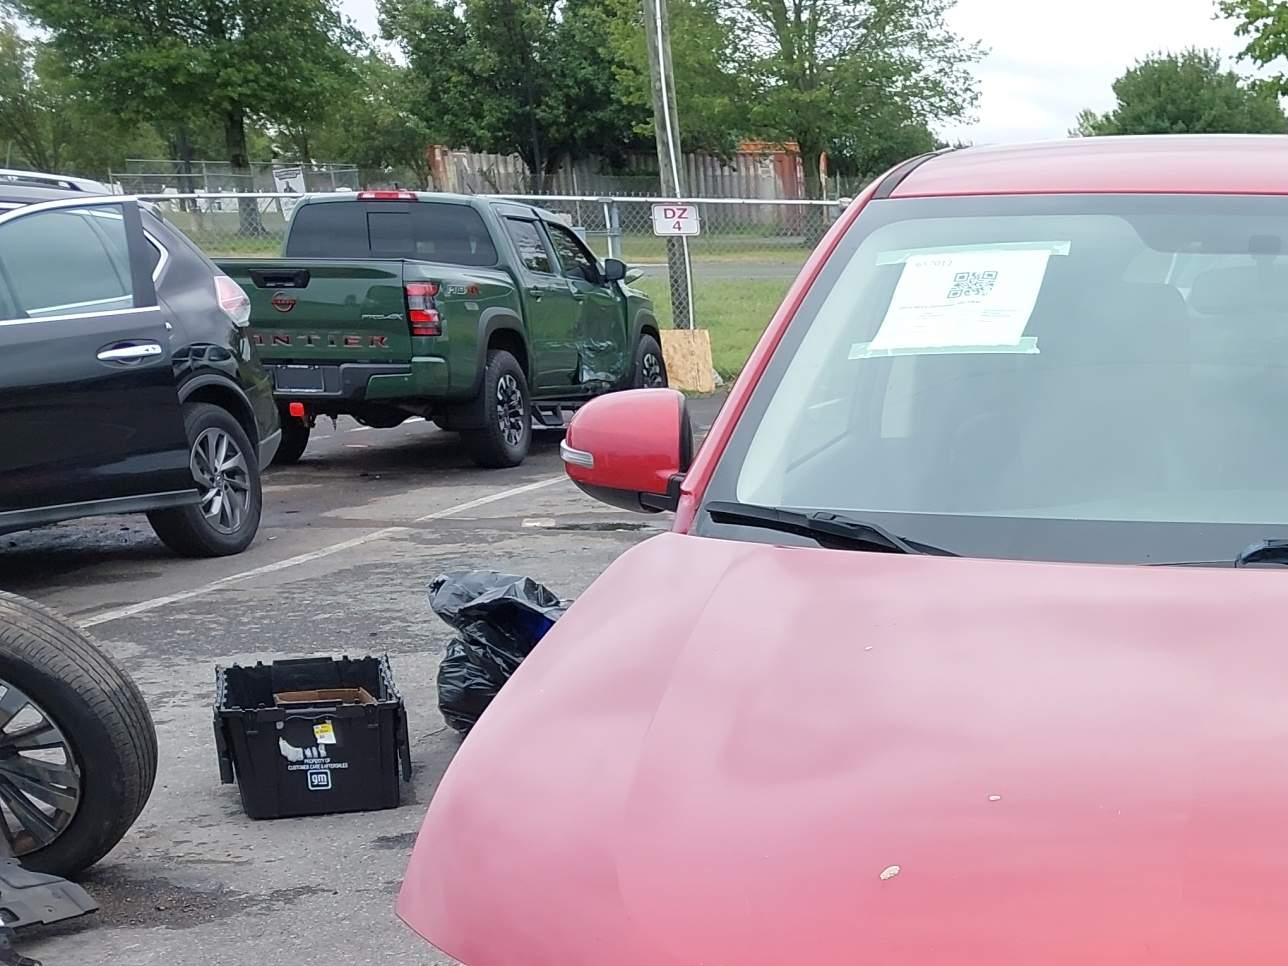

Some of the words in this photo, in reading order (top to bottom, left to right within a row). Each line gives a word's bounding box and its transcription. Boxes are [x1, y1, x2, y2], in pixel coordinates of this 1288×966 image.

[664, 208, 688, 219] DZ
[672, 221, 682, 231] 4
[311, 774, 328, 785] gm
